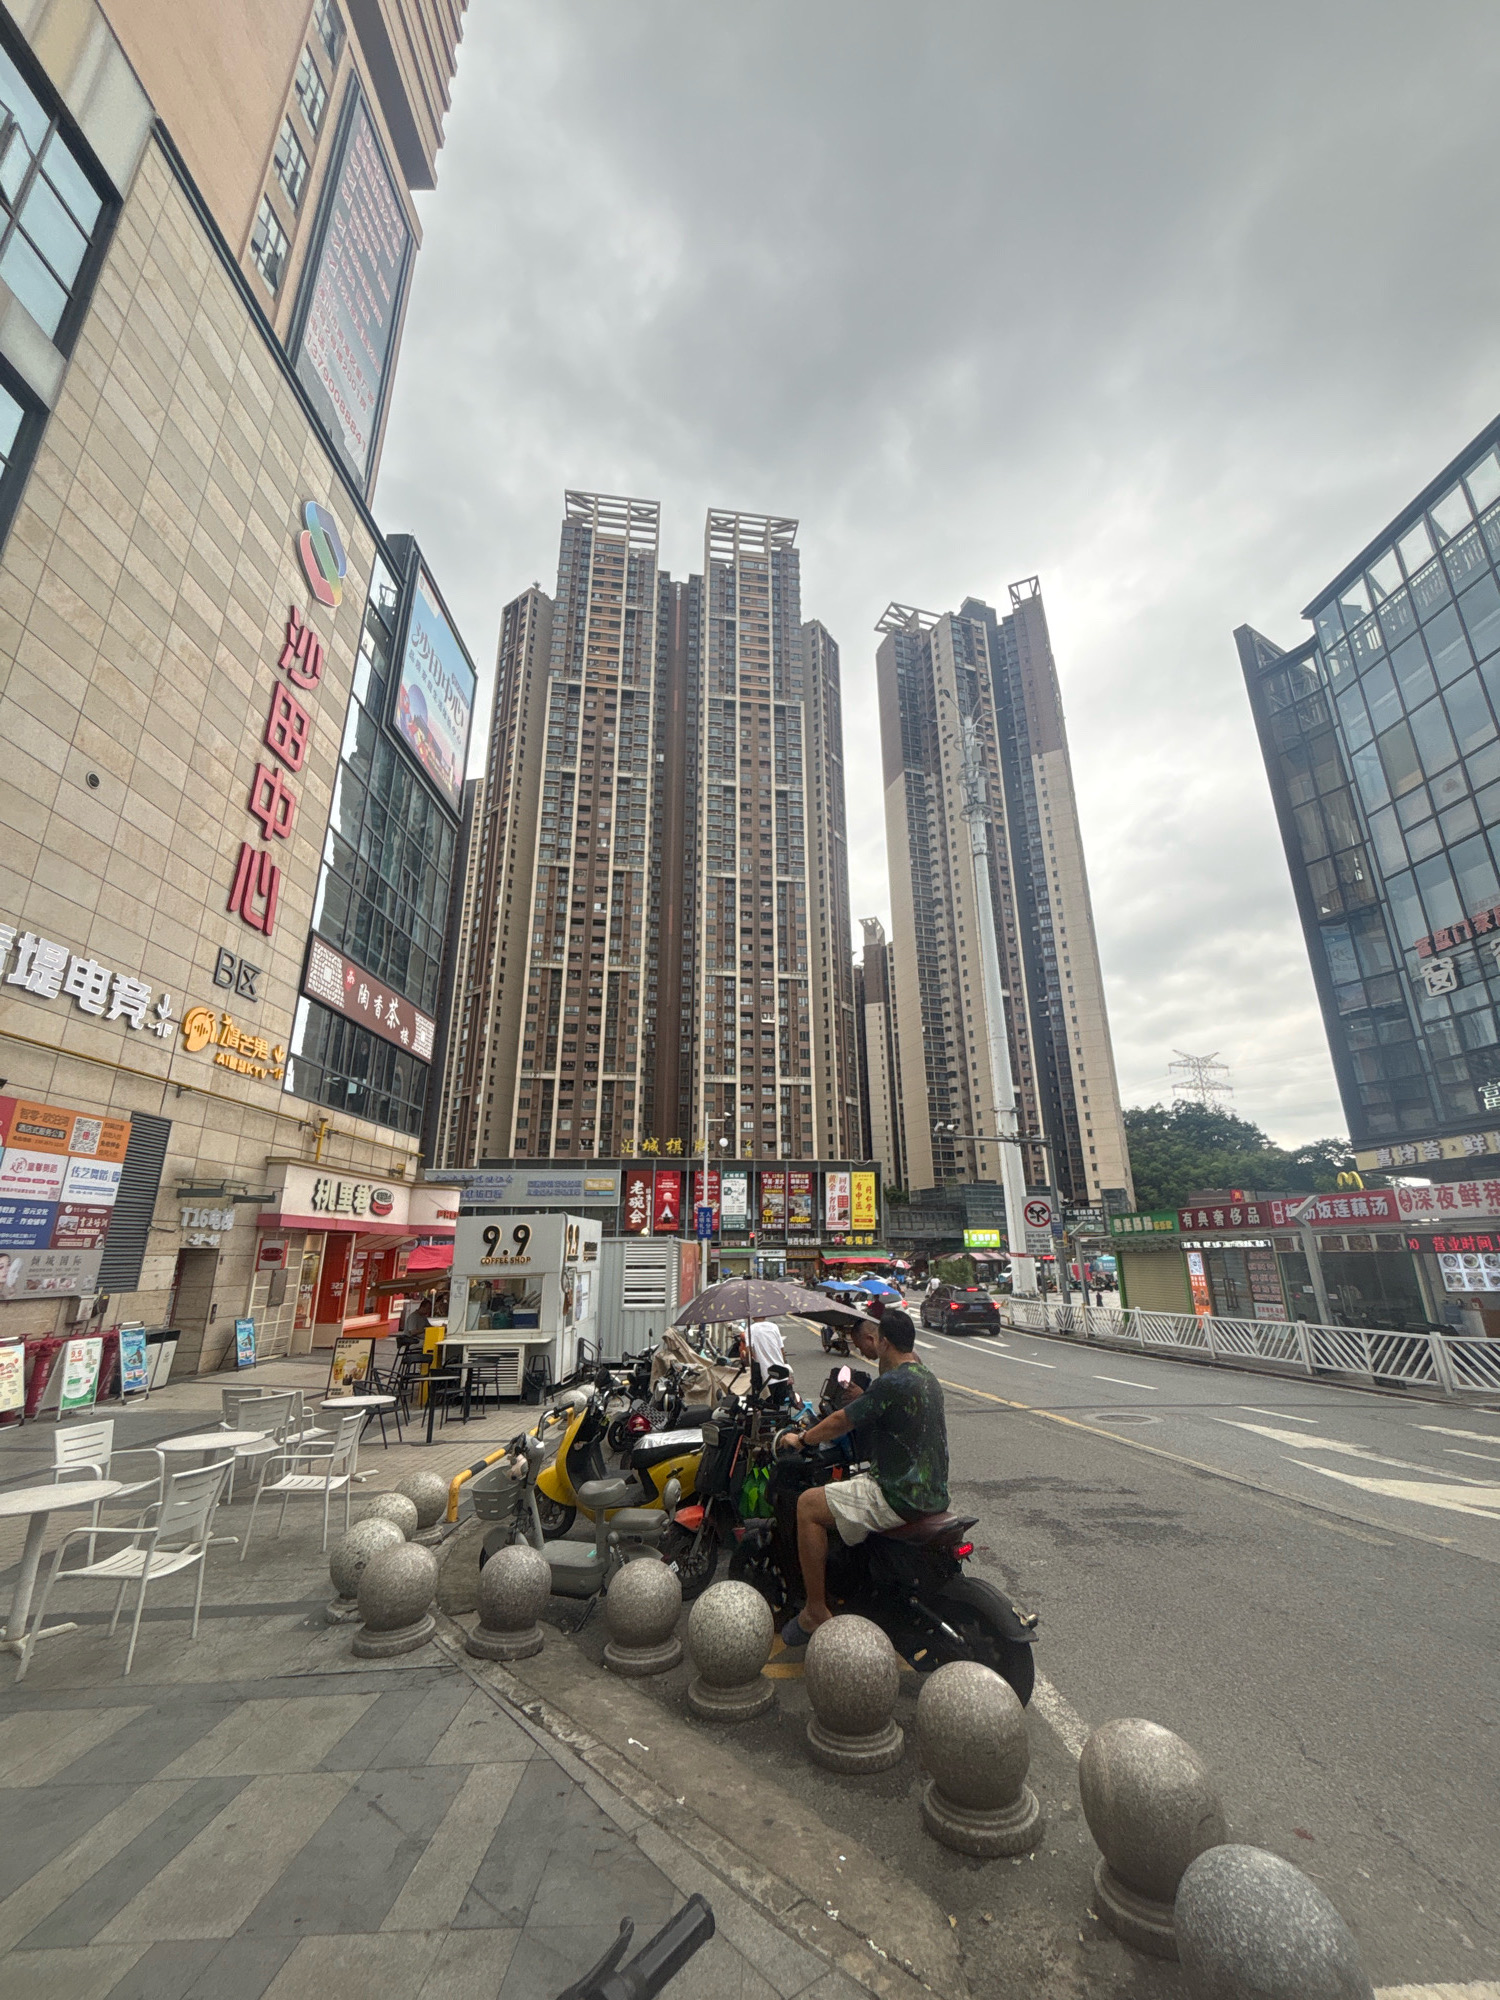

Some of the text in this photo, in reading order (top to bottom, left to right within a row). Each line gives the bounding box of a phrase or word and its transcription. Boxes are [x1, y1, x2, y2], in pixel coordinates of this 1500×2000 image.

[411, 620, 464, 727] 沙田中心
[226, 604, 324, 937] 沙田中心
[213, 947, 261, 1002] B区
[180, 1207, 235, 1231] T16电梯
[482, 1224, 532, 1258] 9.9
[480, 1256, 532, 1265] COFFEE SHOP
